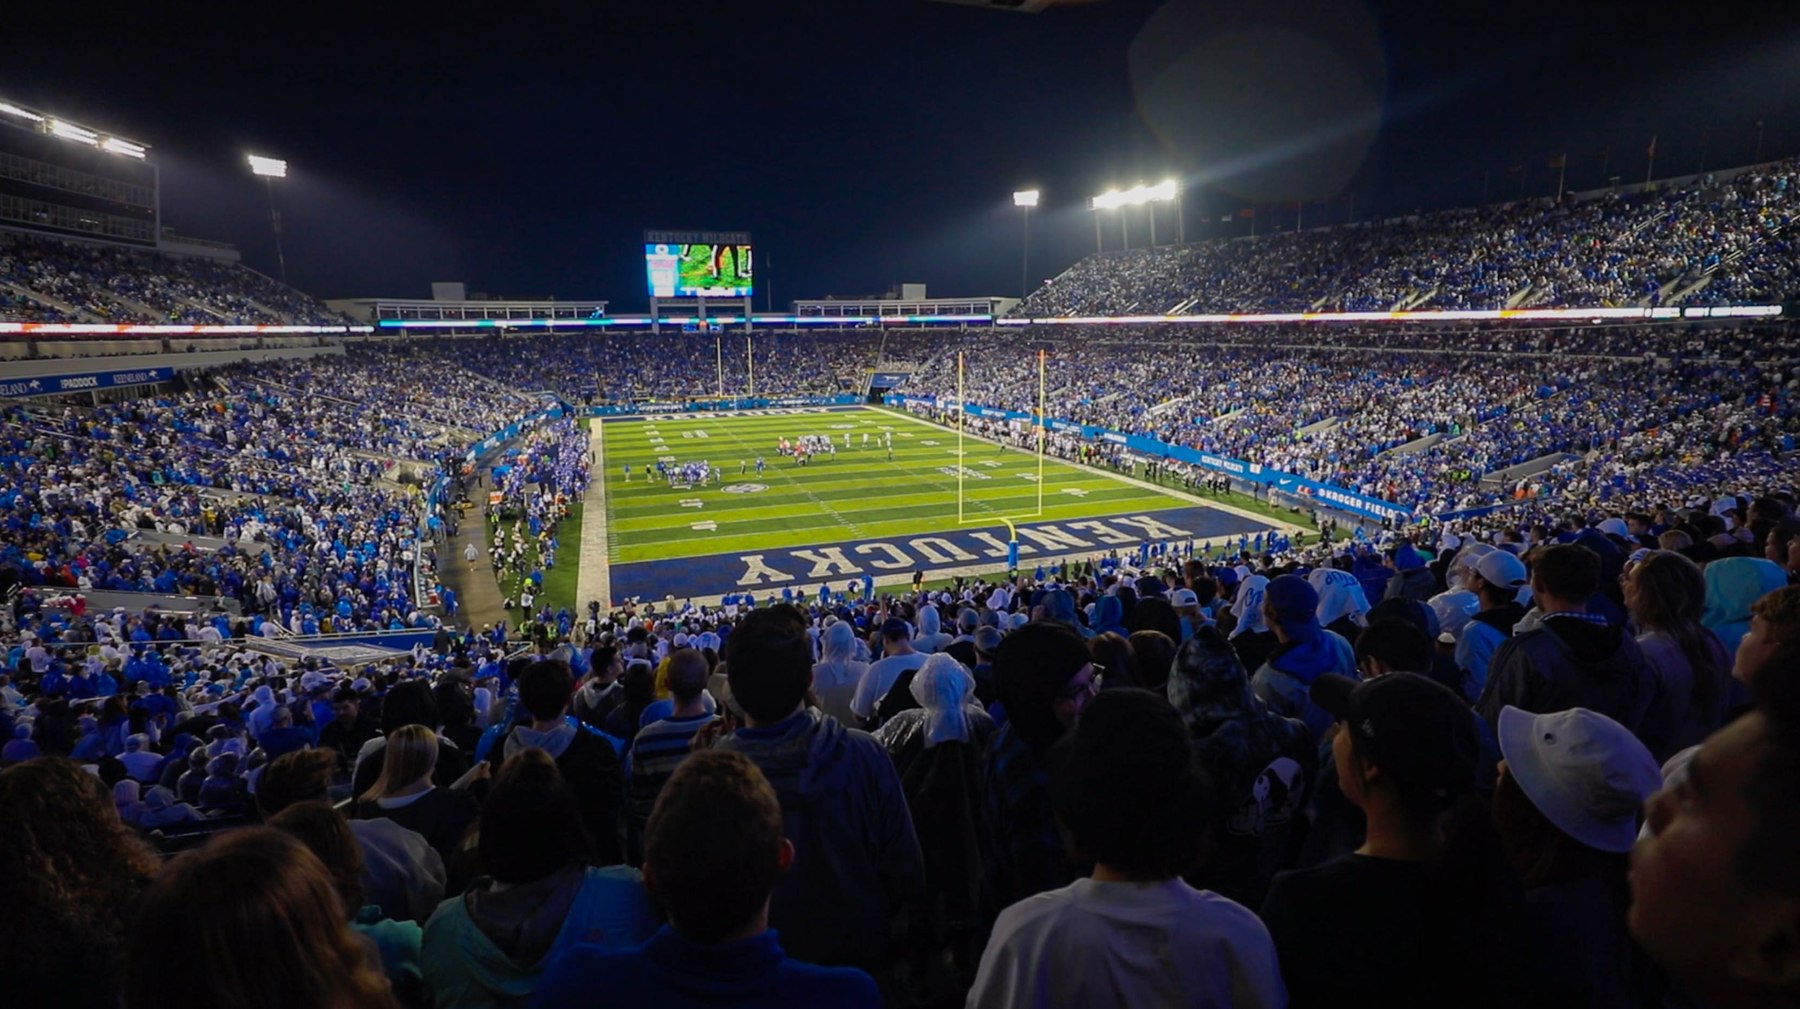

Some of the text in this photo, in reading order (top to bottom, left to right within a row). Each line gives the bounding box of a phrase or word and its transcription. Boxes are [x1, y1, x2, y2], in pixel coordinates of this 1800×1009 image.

[63, 376, 98, 389] PADDOCK
[113, 372, 148, 384] KEENELAND
[1326, 490, 1395, 519] KROGER FIELD
[736, 514, 1194, 586] KENTUCKY
